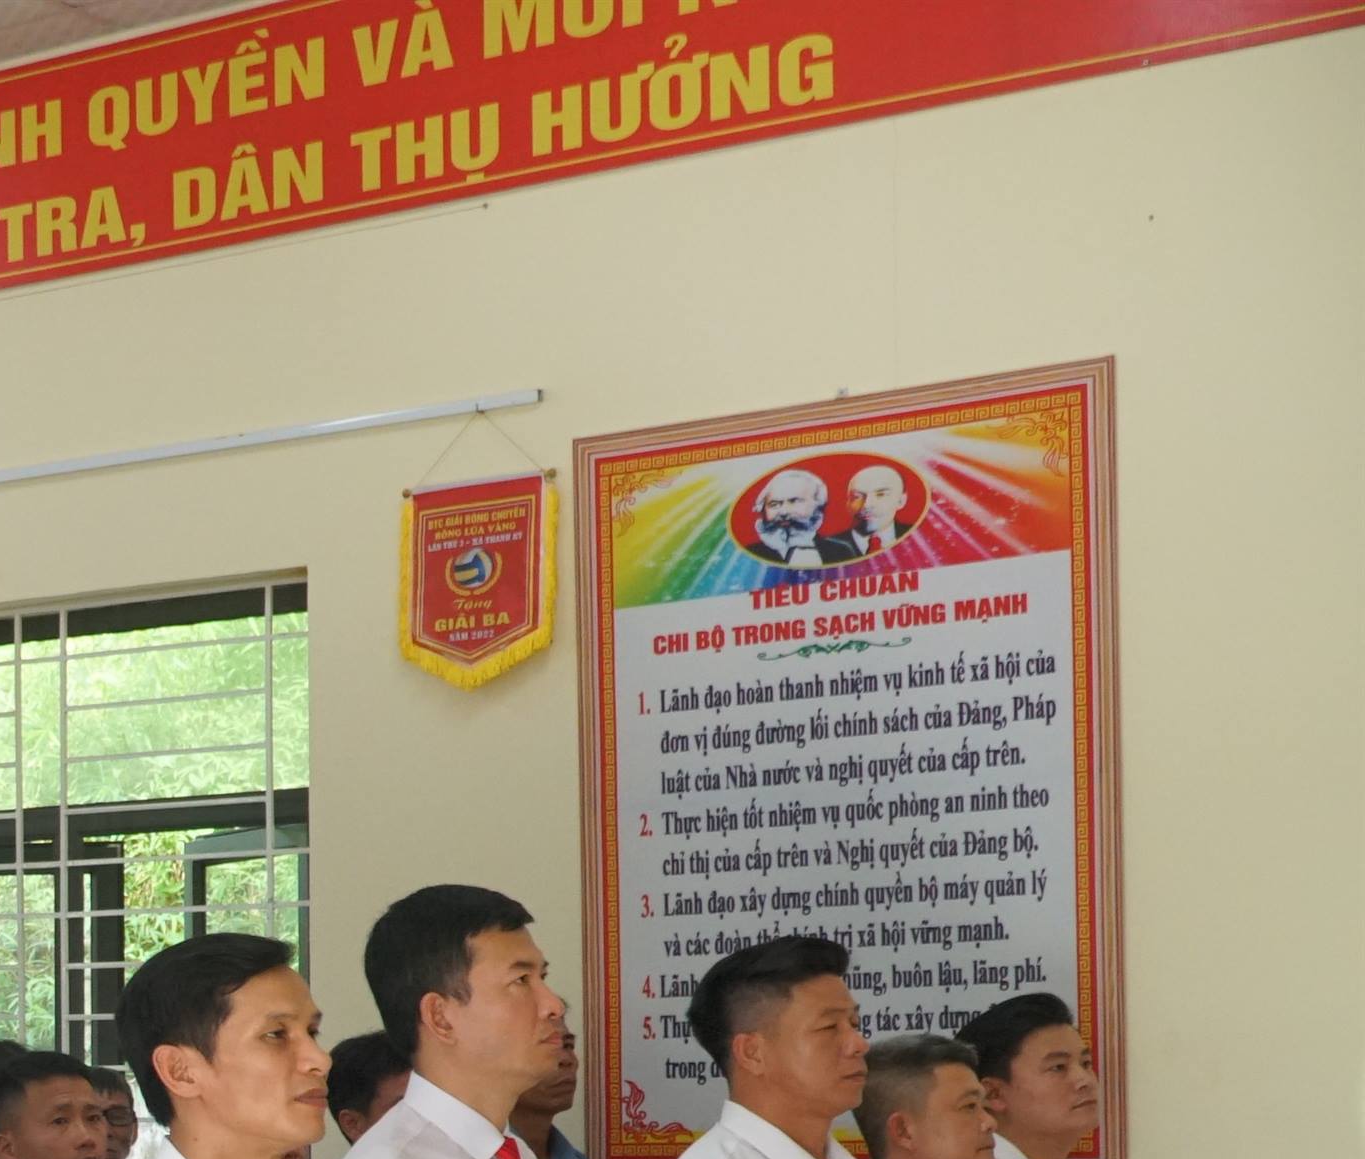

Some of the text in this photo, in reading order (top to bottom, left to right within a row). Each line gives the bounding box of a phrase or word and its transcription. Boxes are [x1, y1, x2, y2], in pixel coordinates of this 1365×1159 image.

[88, 28, 325, 151] QUYỀN
[352, 0, 454, 87] VÀ
[173, 142, 324, 230] DÂN
[350, 102, 500, 192] THỤ
[532, 33, 834, 156] HƯỞNG
[482, 611, 511, 627] BA
[653, 592, 1027, 655] CHI BỘ TRONG SẠCH VỮNG MẠNH
[638, 649, 1055, 714] 1. Lãnh đạo hoàn thanh nhiệm vụ kinh tế xã hội của
[660, 693, 1056, 756] đơn vị đúng đường lối chính sách của Đảng, Pháp
[661, 736, 1025, 799] luật của Nhà nước và nghị quyết của cấp trên.
[639, 783, 1048, 840] 2. Thực hiện tốt nhiệm vụ quốc phòng an ninh theo
[662, 825, 1038, 879] chỉ thị của cấp trên và Nghị quyết của Đảng bộ.
[640, 868, 1046, 919] 3. Lãnh đạo xây dựng chính quyền bộ máy quản lý
[664, 932, 681, 957] và
[686, 932, 710, 956] các
[857, 922, 875, 947] xã
[880, 920, 905, 952] hội
[910, 919, 952, 950] vững
[957, 915, 1008, 948] mạnh.
[642, 975, 655, 999] 4.
[891, 961, 932, 988] buôn
[938, 960, 967, 993] lậu,
[972, 959, 1009, 991] lãng
[1014, 956, 1046, 990] phí.
